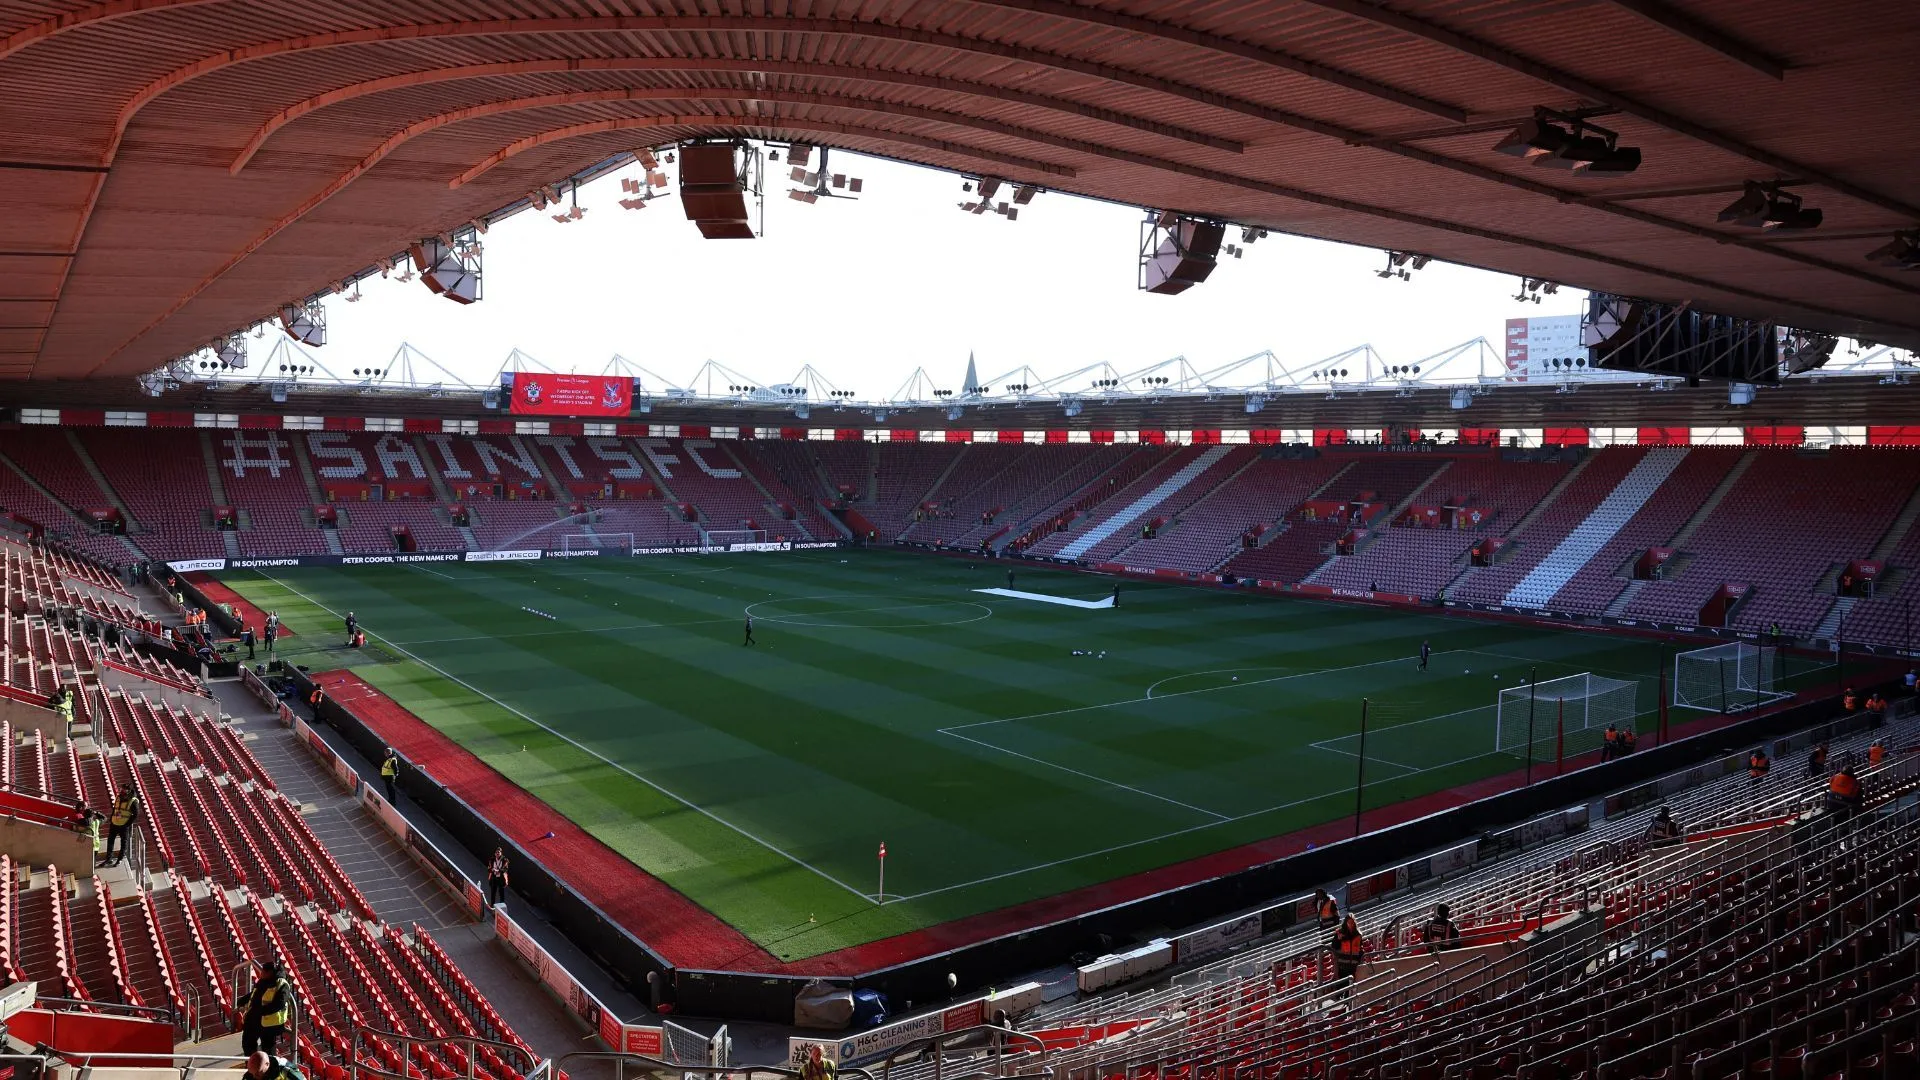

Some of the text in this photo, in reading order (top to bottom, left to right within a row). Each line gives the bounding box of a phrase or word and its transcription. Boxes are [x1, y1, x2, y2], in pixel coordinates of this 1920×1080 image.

[1391, 445, 1417, 453] MARCH
[241, 559, 299, 567] SOUTHAMPTON
[1342, 589, 1364, 597] MARCH
[947, 1003, 978, 1018] WARNING
[857, 1020, 926, 1047] H&C CLEANING
[857, 1029, 926, 1056] AND MAINTENANCE
